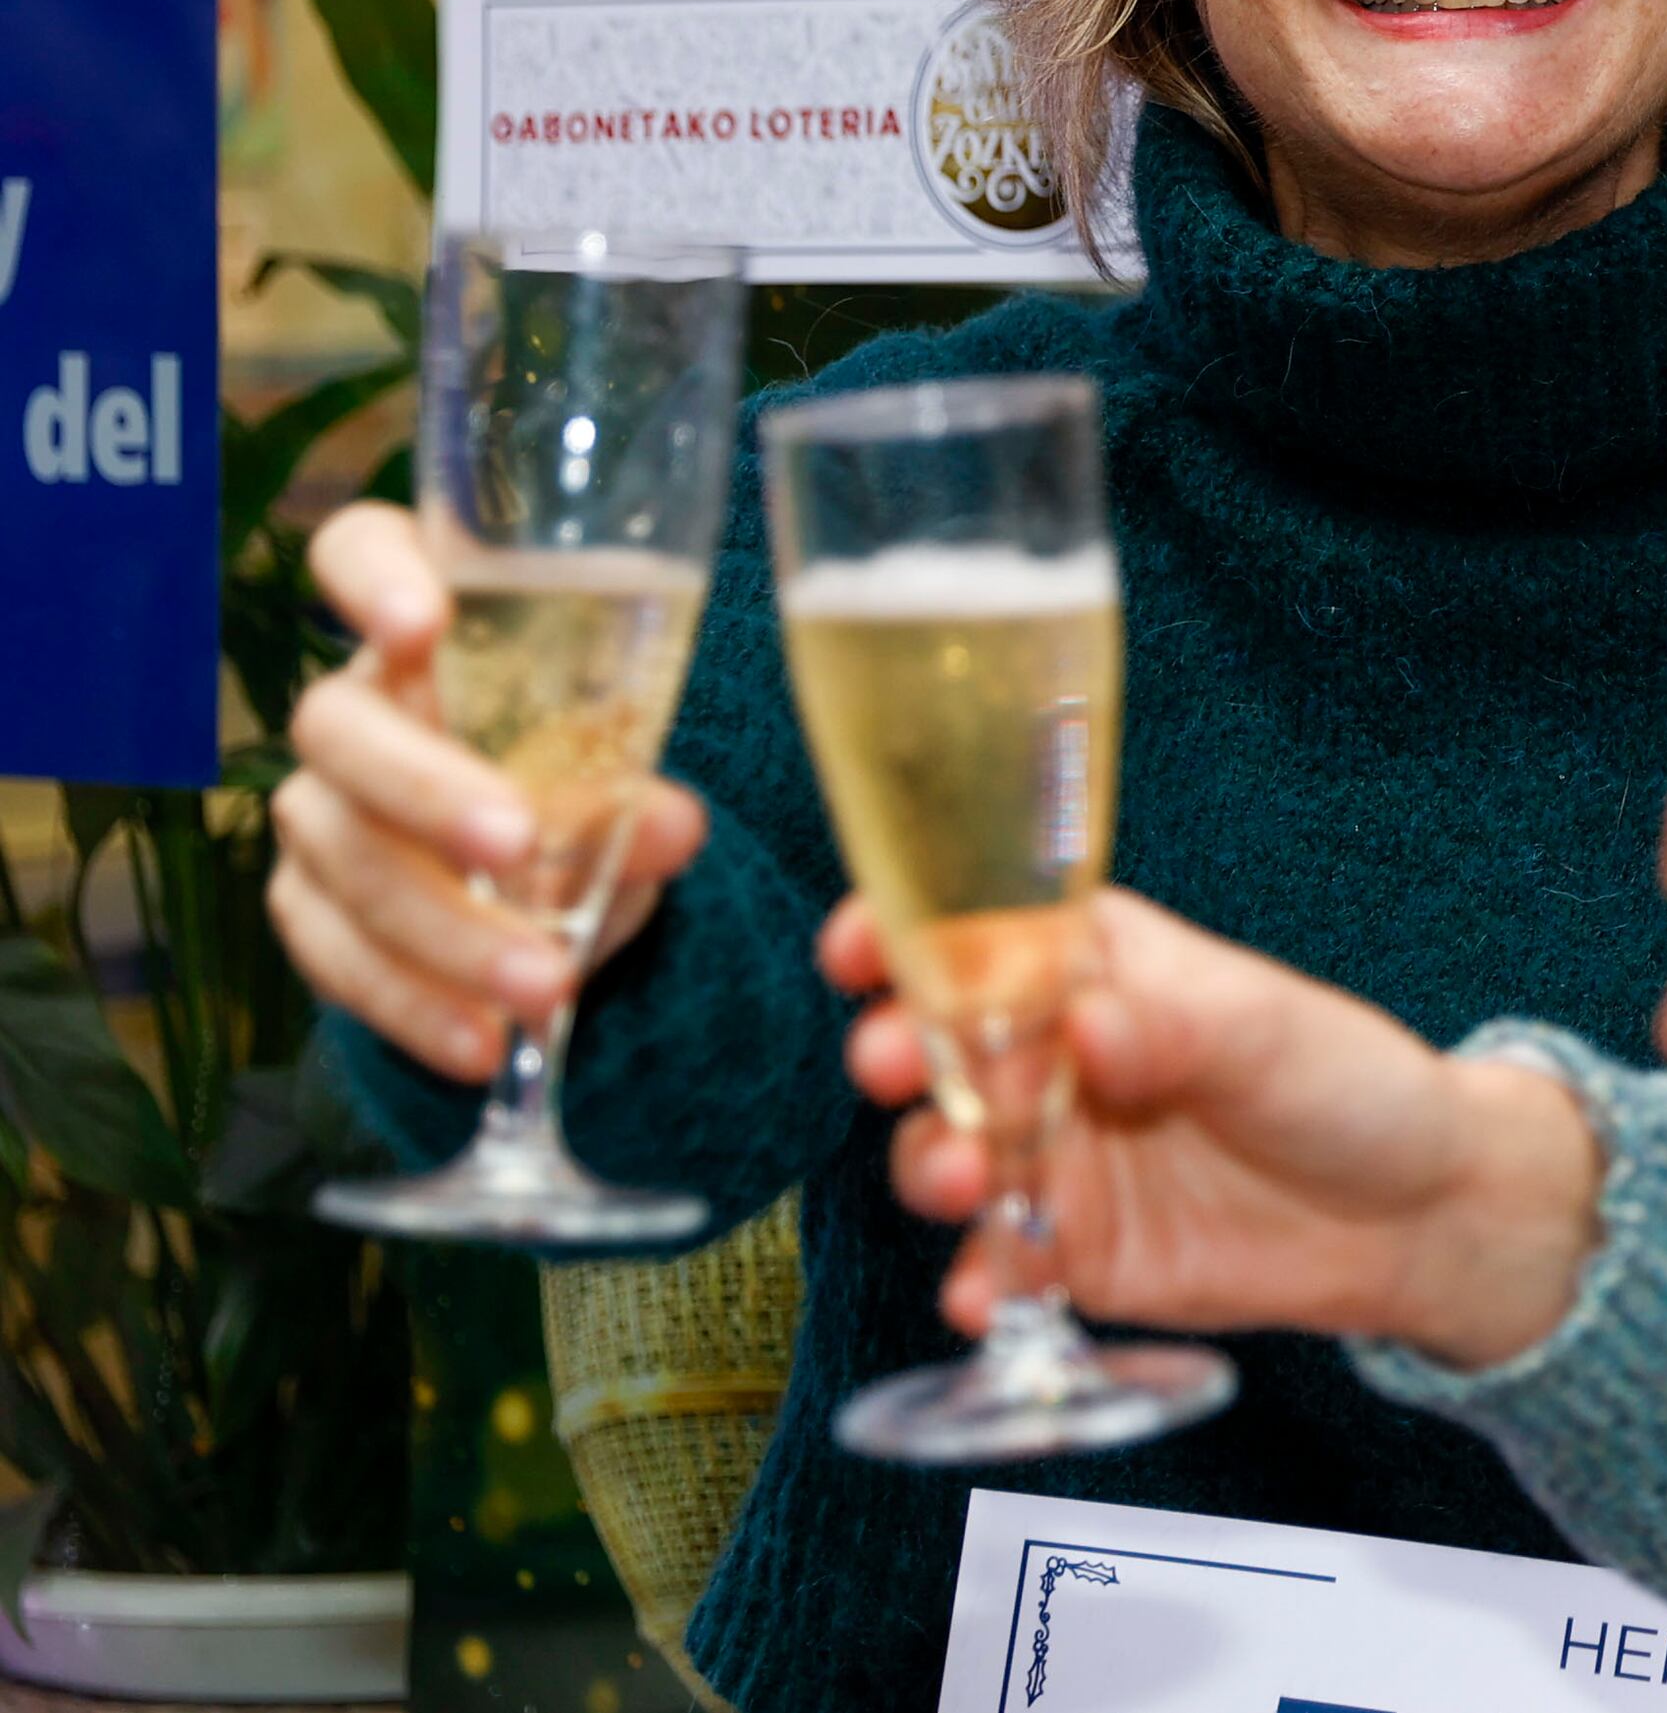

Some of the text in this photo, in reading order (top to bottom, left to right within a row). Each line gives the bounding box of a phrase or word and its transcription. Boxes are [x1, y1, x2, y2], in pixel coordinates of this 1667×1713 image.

[489, 105, 902, 145] GABONETAKO LOTERIA
[22, 348, 183, 487] del
